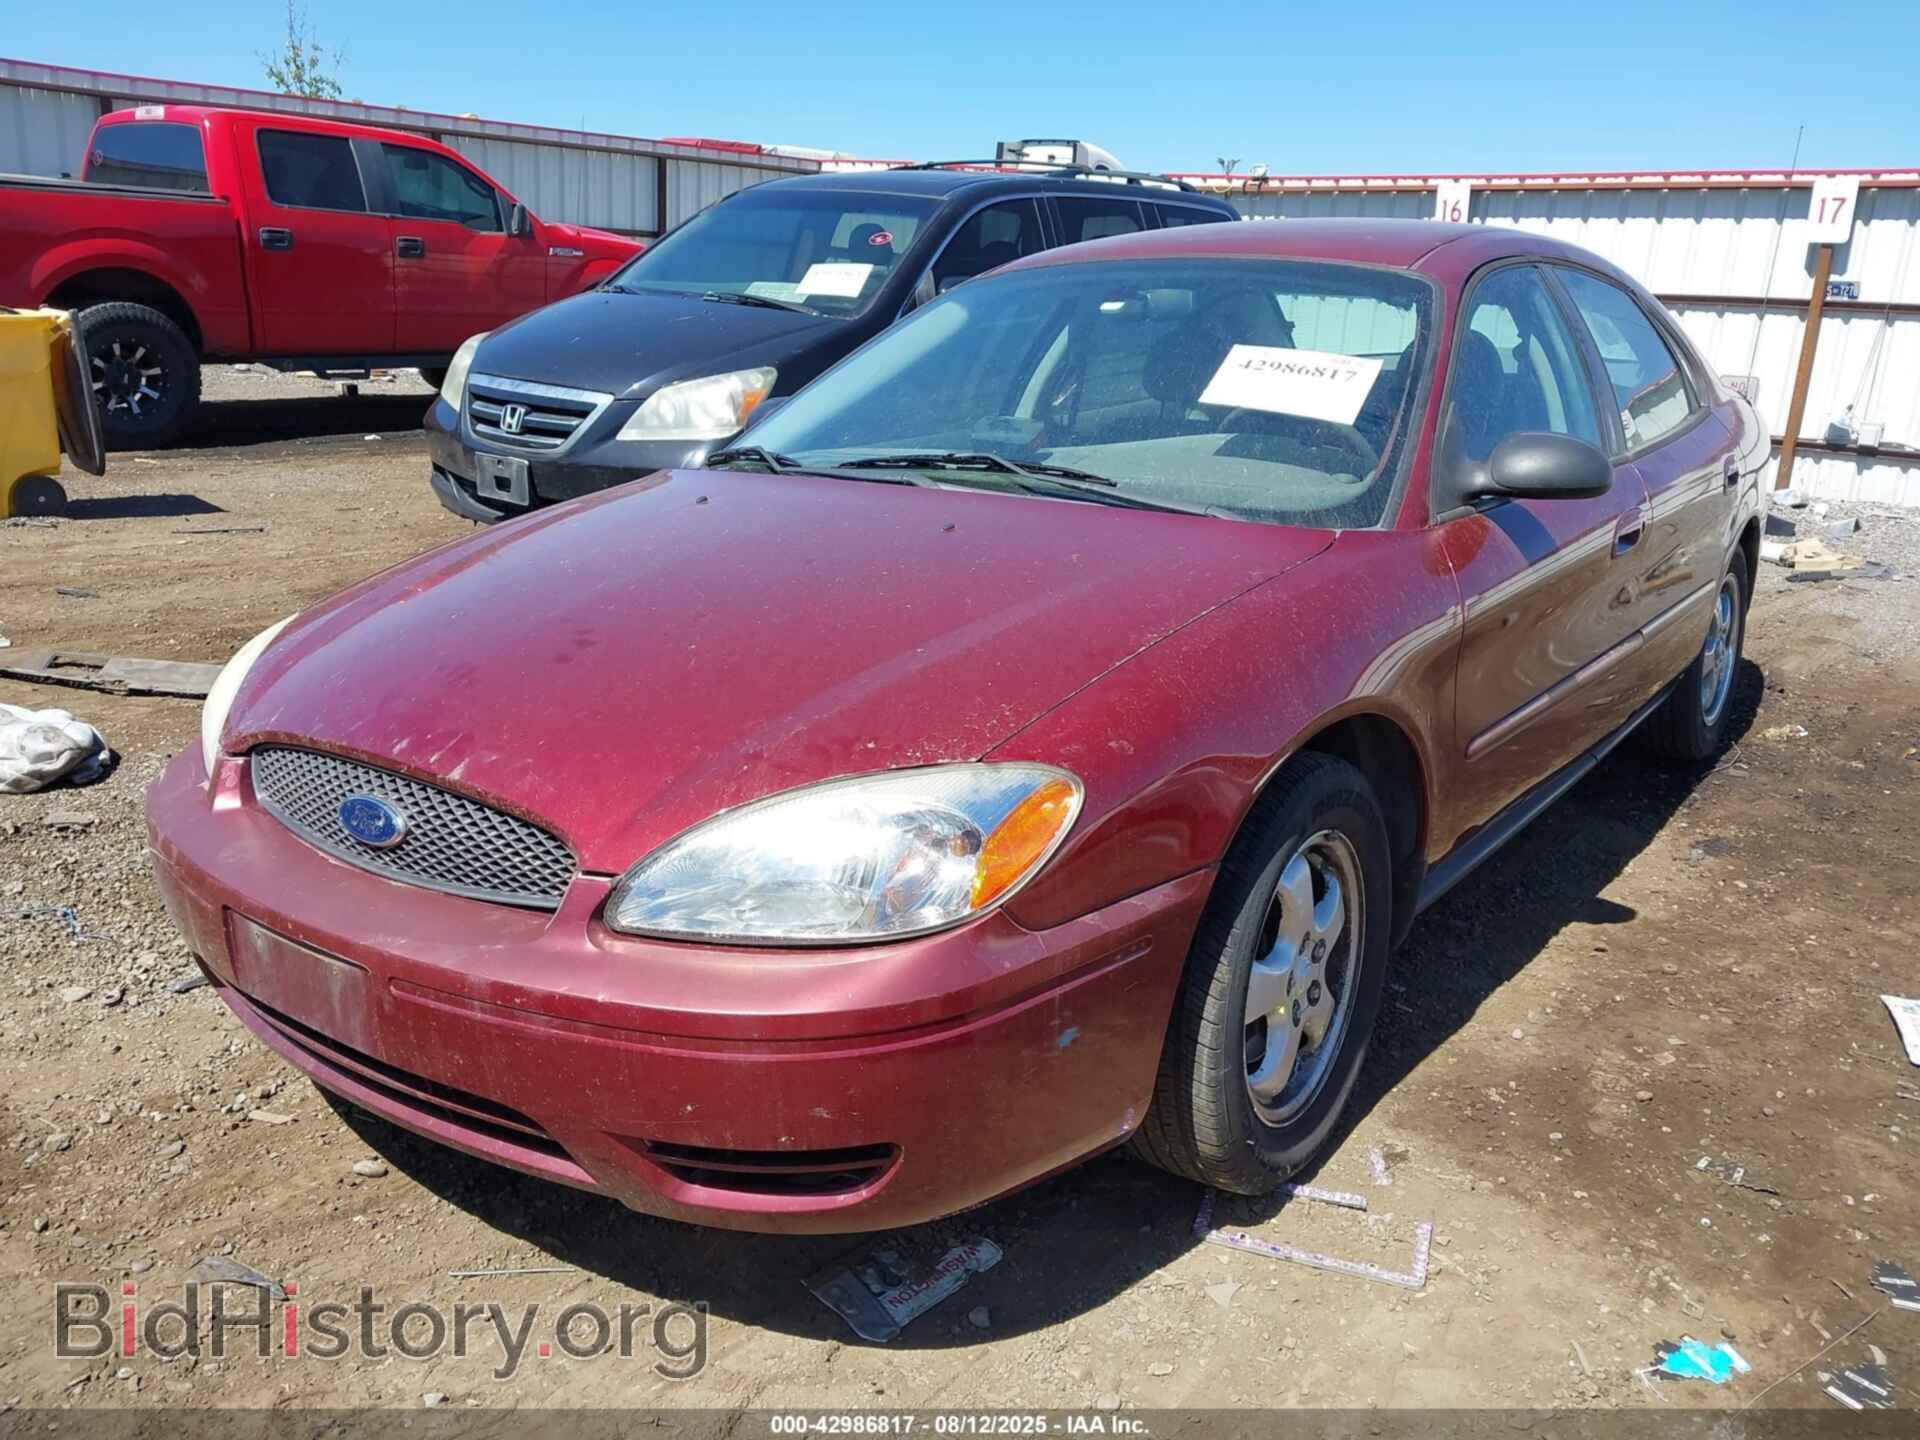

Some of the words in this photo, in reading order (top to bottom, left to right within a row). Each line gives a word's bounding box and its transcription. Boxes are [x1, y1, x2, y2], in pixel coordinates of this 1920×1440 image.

[1442, 199, 1462, 223] 16
[1818, 197, 1847, 224] 17
[1238, 359, 1358, 382] 42986817
